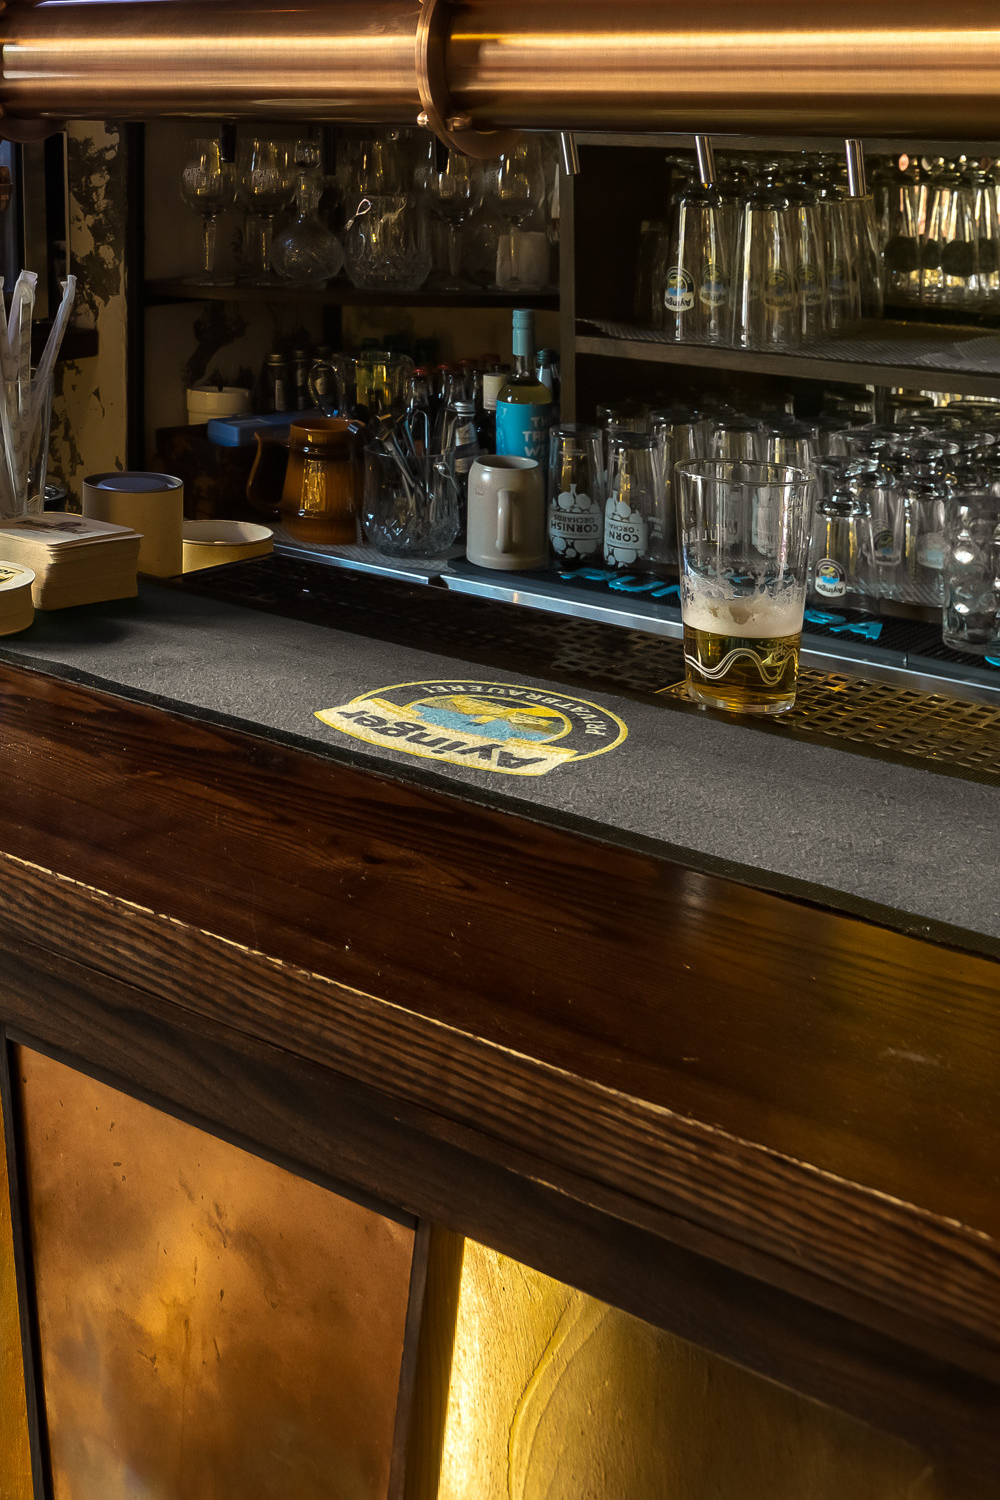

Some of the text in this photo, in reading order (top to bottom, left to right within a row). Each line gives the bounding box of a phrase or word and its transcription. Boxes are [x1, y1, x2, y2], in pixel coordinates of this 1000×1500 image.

[551, 522, 598, 533] CORNISH
[609, 531, 639, 543] CORN
[422, 684, 608, 737] PRIVATBRAUEREI
[337, 708, 548, 769] Ayinger
